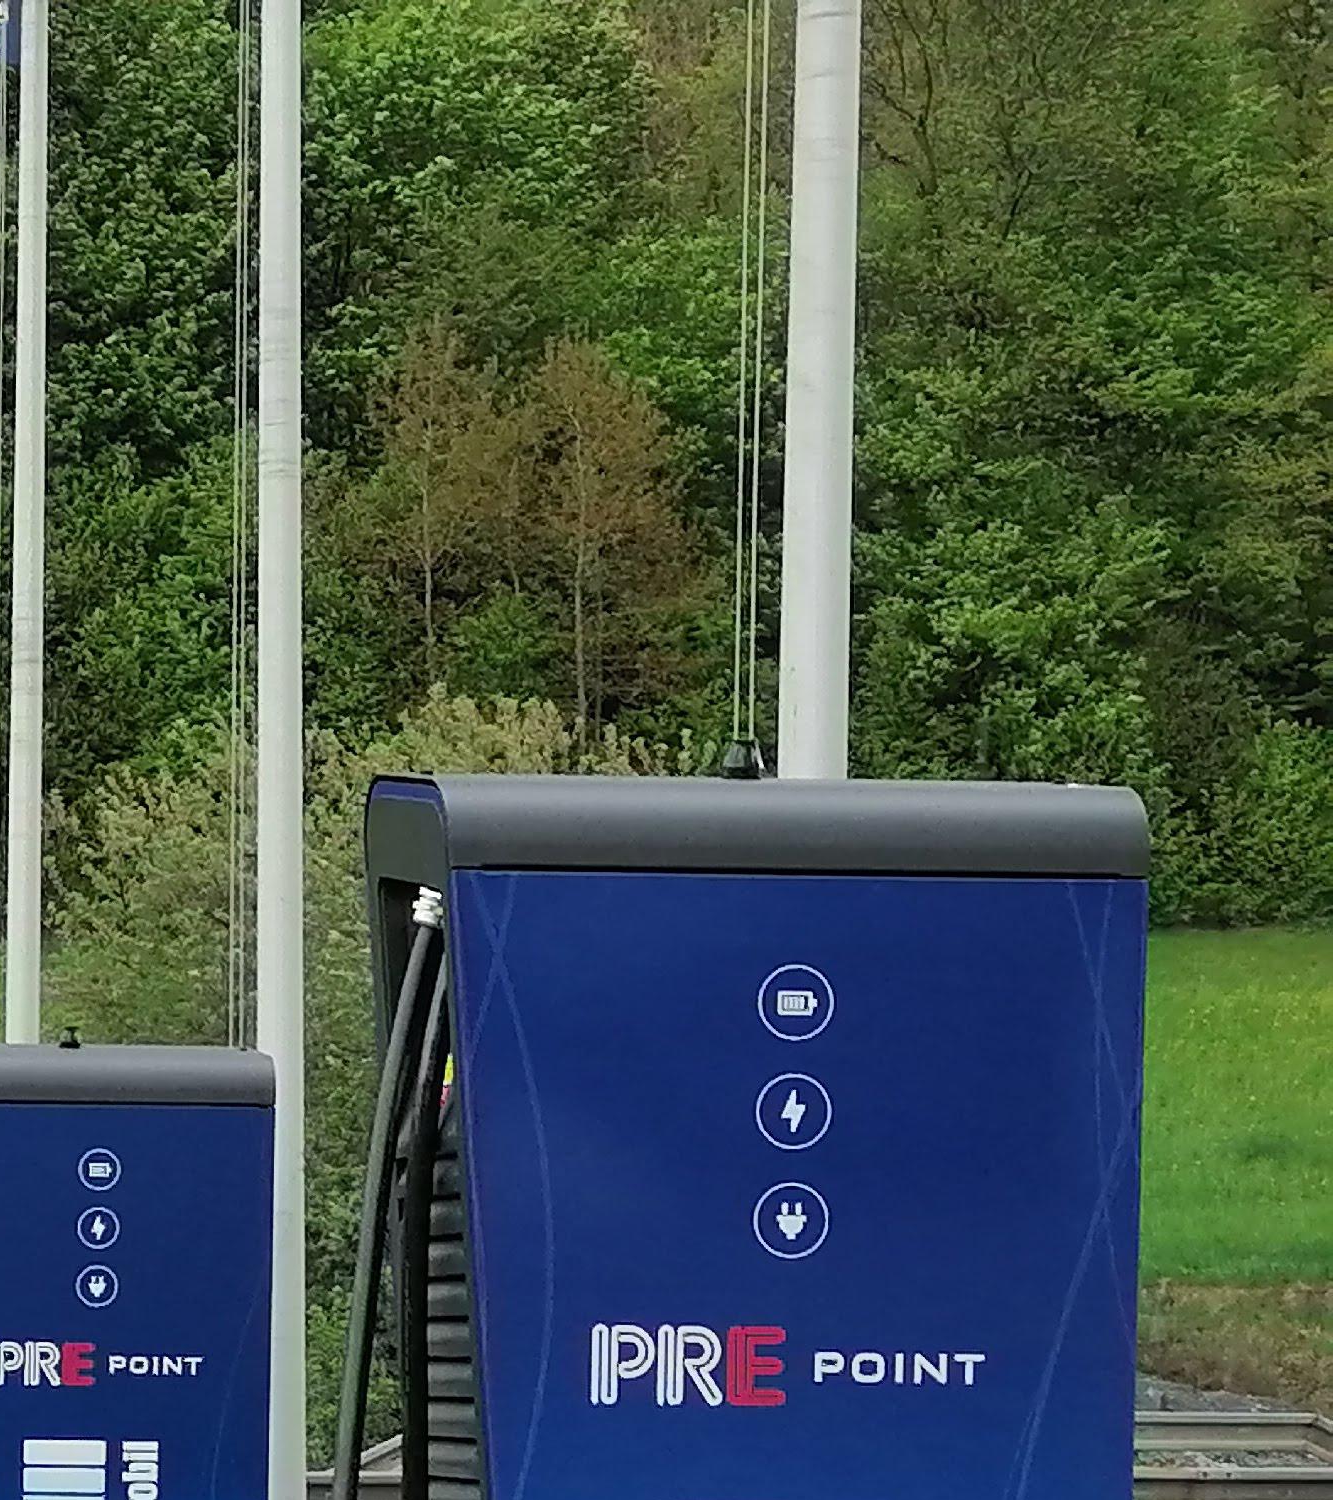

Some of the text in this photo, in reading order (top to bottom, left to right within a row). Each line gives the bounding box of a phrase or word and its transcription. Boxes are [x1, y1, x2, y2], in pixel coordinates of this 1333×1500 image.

[108, 1355, 204, 1376] POINT
[590, 1323, 987, 1407] PRE POINT
